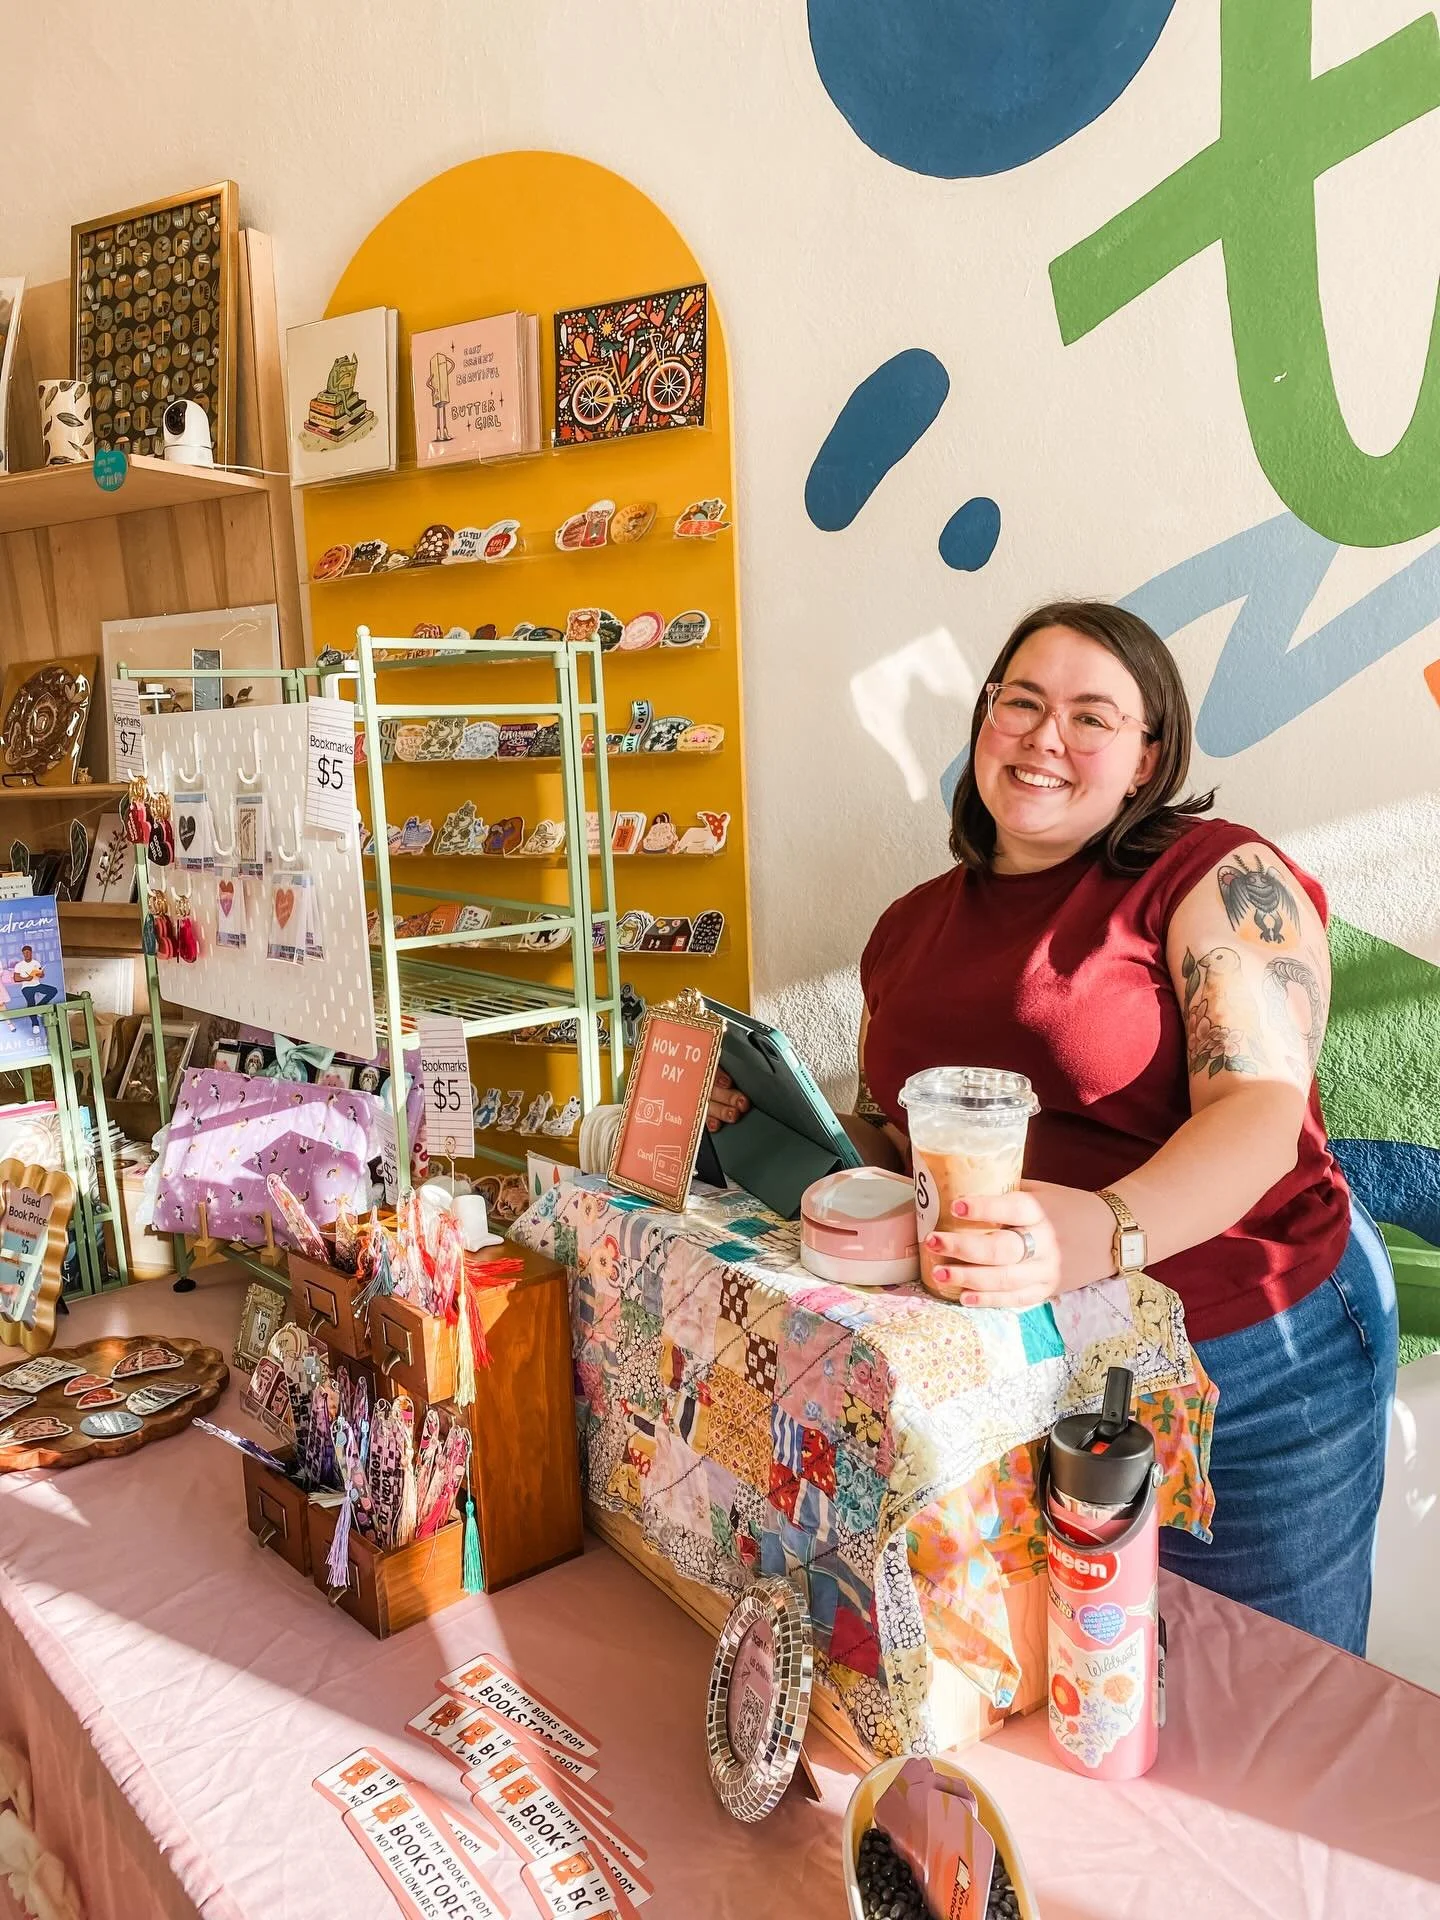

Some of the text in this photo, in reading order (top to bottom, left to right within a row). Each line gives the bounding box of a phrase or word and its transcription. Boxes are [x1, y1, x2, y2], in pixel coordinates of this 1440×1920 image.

[451, 399, 496, 420] BUTTER
[475, 414, 502, 431] GIRL
[460, 539, 475, 549] YOU
[120, 728, 136, 757] $7
[310, 734, 354, 755] Bookmarks
[317, 753, 344, 790] $5
[651, 1037, 701, 1063] HOW TO
[421, 1059, 468, 1073] Bookmarks
[660, 1063, 685, 1084] PAY
[432, 1076, 461, 1113] $5
[664, 1113, 684, 1126] Cash
[637, 1148, 654, 1162] Card
[22, 1193, 41, 1208] Used
[8, 1206, 49, 1228] Book Price
[21, 1238, 30, 1255] $5
[16, 1269, 26, 1287] $8
[380, 1469, 392, 1526] BORN TO
[501, 1682, 520, 1699] BUY
[518, 1695, 534, 1708] MY
[531, 1706, 560, 1730] BOOKS
[558, 1729, 586, 1751] FROM
[466, 1753, 482, 1767] NO
[348, 1794, 364, 1807] NO
[506, 1814, 527, 1833] NOT
[539, 1794, 581, 1835] I BUY MY
[374, 1833, 394, 1853] NOT
[415, 1821, 435, 1840] BUY
[429, 1841, 447, 1856] MY
[441, 1857, 470, 1889] BOOKS
[465, 1889, 494, 1918] FROM
[389, 1854, 440, 1918] BILLIONAIRES
[594, 1886, 611, 1902] BU
[552, 1896, 568, 1913] NO
[955, 1886, 967, 1920] Nove
